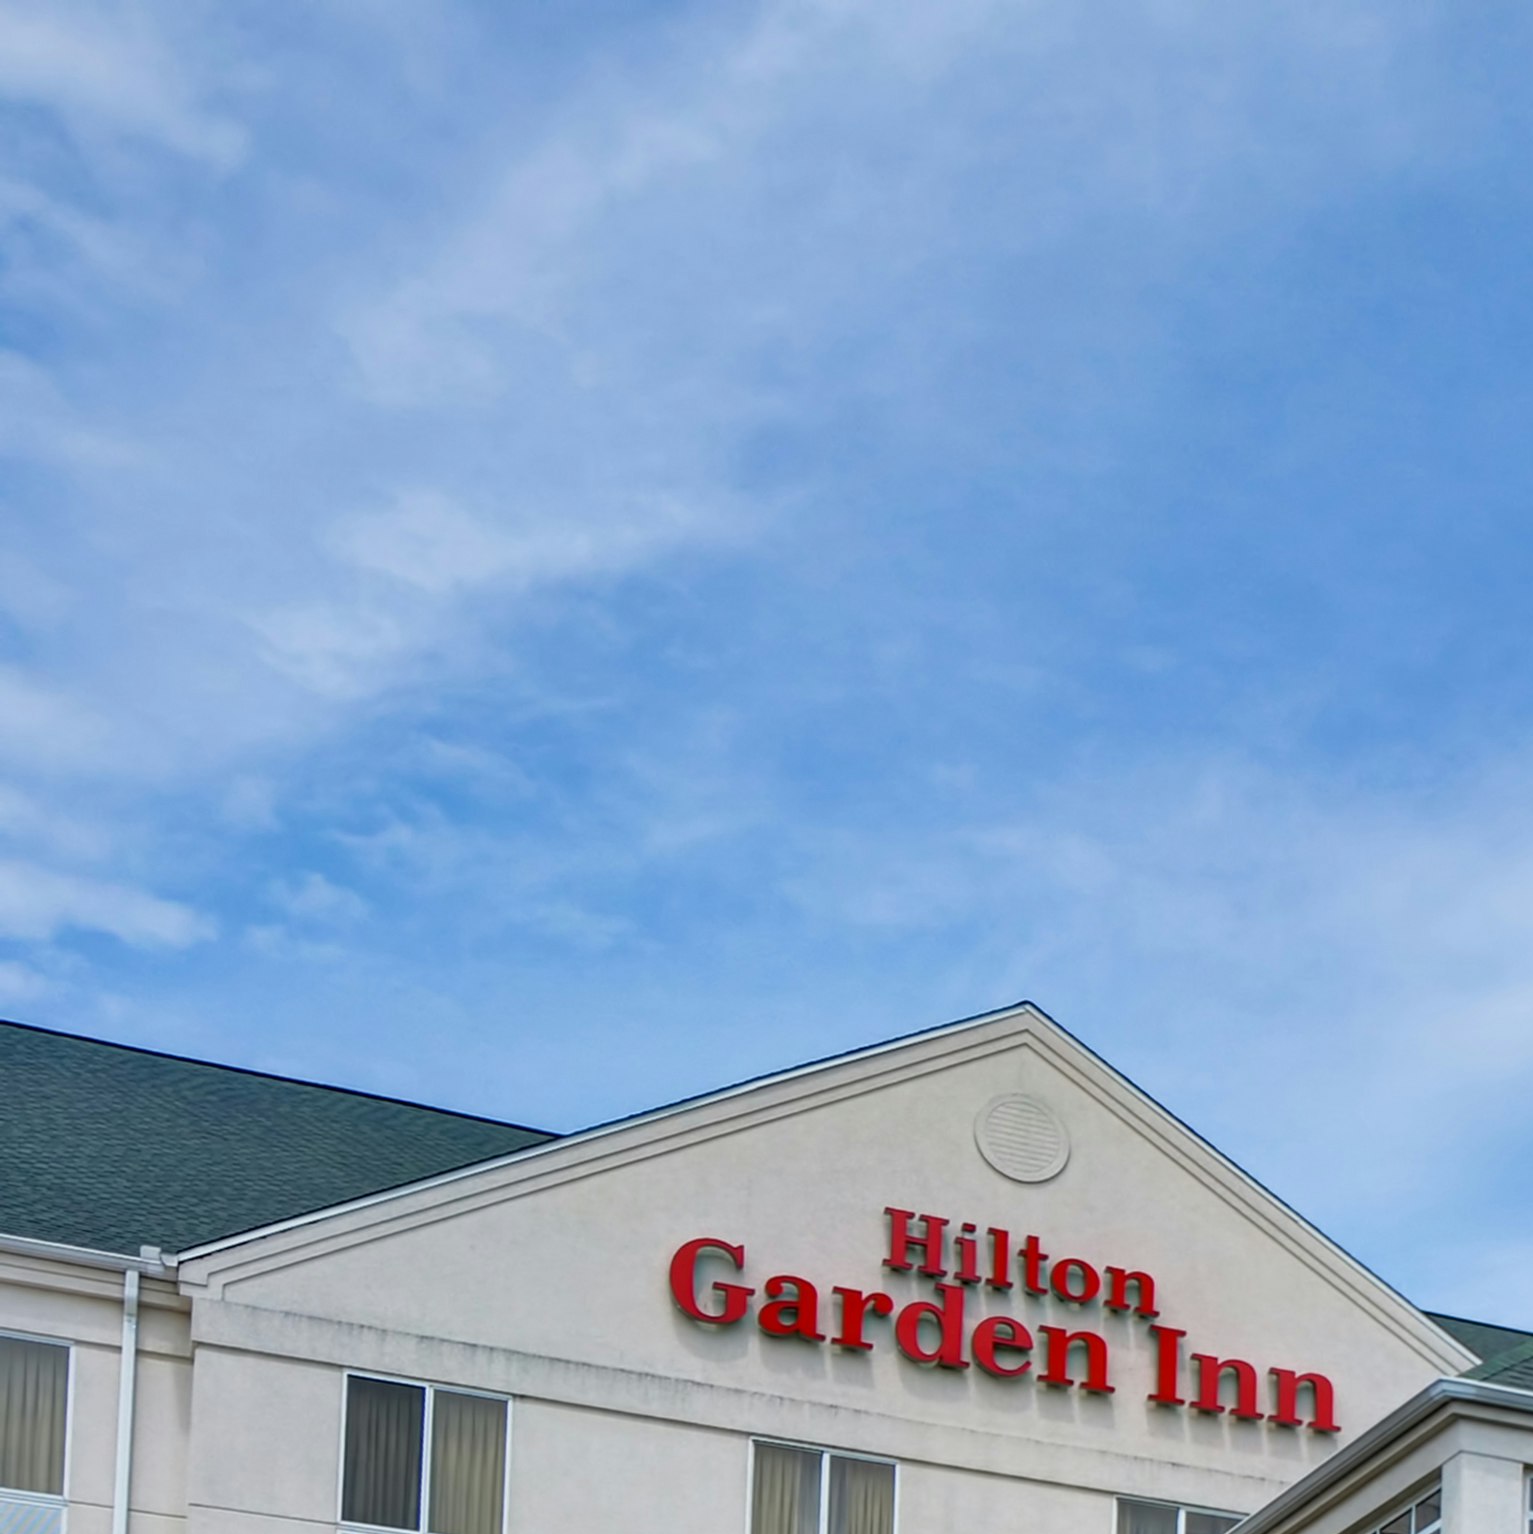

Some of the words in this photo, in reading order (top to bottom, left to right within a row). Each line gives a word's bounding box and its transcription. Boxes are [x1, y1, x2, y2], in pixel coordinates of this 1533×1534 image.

[669, 1237, 1115, 1394] Garden
[1147, 1324, 1341, 1432] Inn
[882, 1206, 1159, 1318] Hilton
